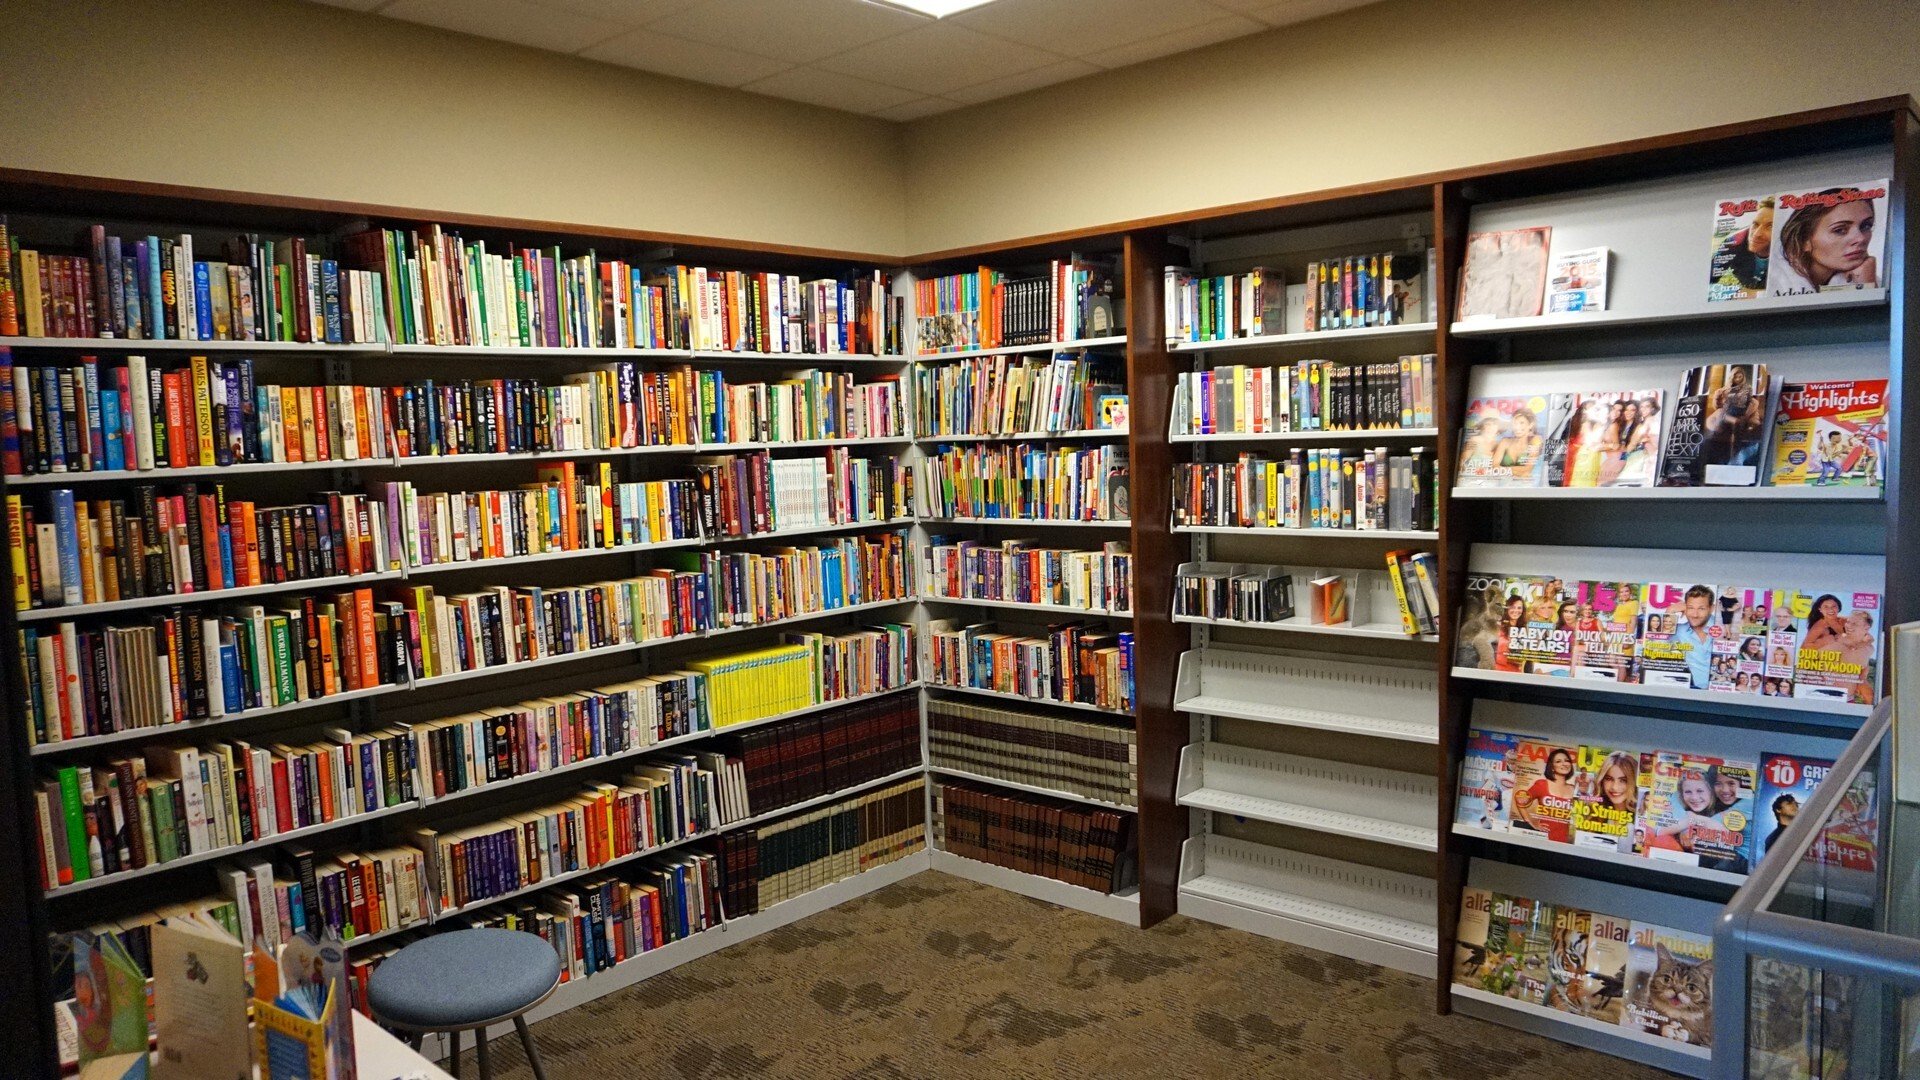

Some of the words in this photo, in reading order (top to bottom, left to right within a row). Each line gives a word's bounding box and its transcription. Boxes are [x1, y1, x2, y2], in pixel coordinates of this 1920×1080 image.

[324, 272, 332, 294] FLYNN
[330, 274, 338, 292] VINCE
[1711, 283, 1739, 292] Chris
[1711, 291, 1748, 300] Martin
[332, 304, 340, 338] MEMORIAL
[194, 359, 206, 386] JAMES
[168, 387, 179, 402] JAMES
[1810, 382, 1855, 391] Welcome!
[1678, 404, 1700, 417] 650
[1783, 390, 1880, 412] Highlights
[90, 410, 100, 428] TRAIN
[171, 402, 180, 426] PATTERSON
[198, 388, 210, 436] PATTERSON
[487, 406, 496, 430] COOL
[154, 422, 166, 456] Outlaws
[1667, 445, 1700, 458] SEXY!
[1462, 458, 1494, 468] KATHIE
[1488, 466, 1513, 476] HODA
[144, 490, 152, 516] VINCE
[216, 484, 224, 504] James
[60, 506, 68, 530] firefly
[218, 504, 226, 523] Swain
[359, 511, 368, 521] LEE
[9, 502, 22, 548] LONGSHOT
[78, 513, 88, 543] DEWEY
[146, 518, 156, 544] FLYNN
[191, 520, 200, 544] FINDER
[348, 522, 356, 542] CHILD
[360, 522, 368, 536] CHILD
[306, 600, 314, 614] CLIVE
[174, 611, 182, 650] UNCOMMON
[188, 616, 198, 638] JAMES
[1509, 627, 1546, 642] BABY
[1546, 630, 1572, 643] JOY
[278, 633, 286, 658] WORLD
[1521, 640, 1570, 654] TEARS!
[1576, 631, 1600, 642] DUCK
[1602, 632, 1634, 644] WIVES
[396, 640, 405, 666] SCORPIA
[1584, 642, 1606, 654] TELL
[1608, 643, 1625, 654] ALL
[1798, 649, 1818, 660] OUR
[1820, 650, 1841, 662] HOT
[192, 640, 202, 680] PATTERSON
[365, 652, 375, 674] FREEDOM
[1797, 659, 1861, 674] HONEYMOON
[280, 660, 290, 695] ALMANAC
[387, 752, 396, 781] CELEBRITY
[1770, 766, 1796, 784] 10
[128, 799, 138, 822] KRENTZ
[1536, 805, 1572, 819] ESTEFA
[1543, 796, 1572, 809] Glori
[1573, 800, 1590, 814] No
[1592, 802, 1634, 822] Strings
[1576, 816, 1628, 836] Romance
[1688, 826, 1744, 847] FRIEND
[300, 858, 315, 887] DRIVING
[352, 876, 360, 885] LEE
[304, 889, 316, 909] FORCE
[353, 886, 363, 900] CHILD
[1466, 894, 1491, 912] alla
[590, 895, 598, 924] CLASS
[1626, 1004, 1669, 1022] Bubillion
